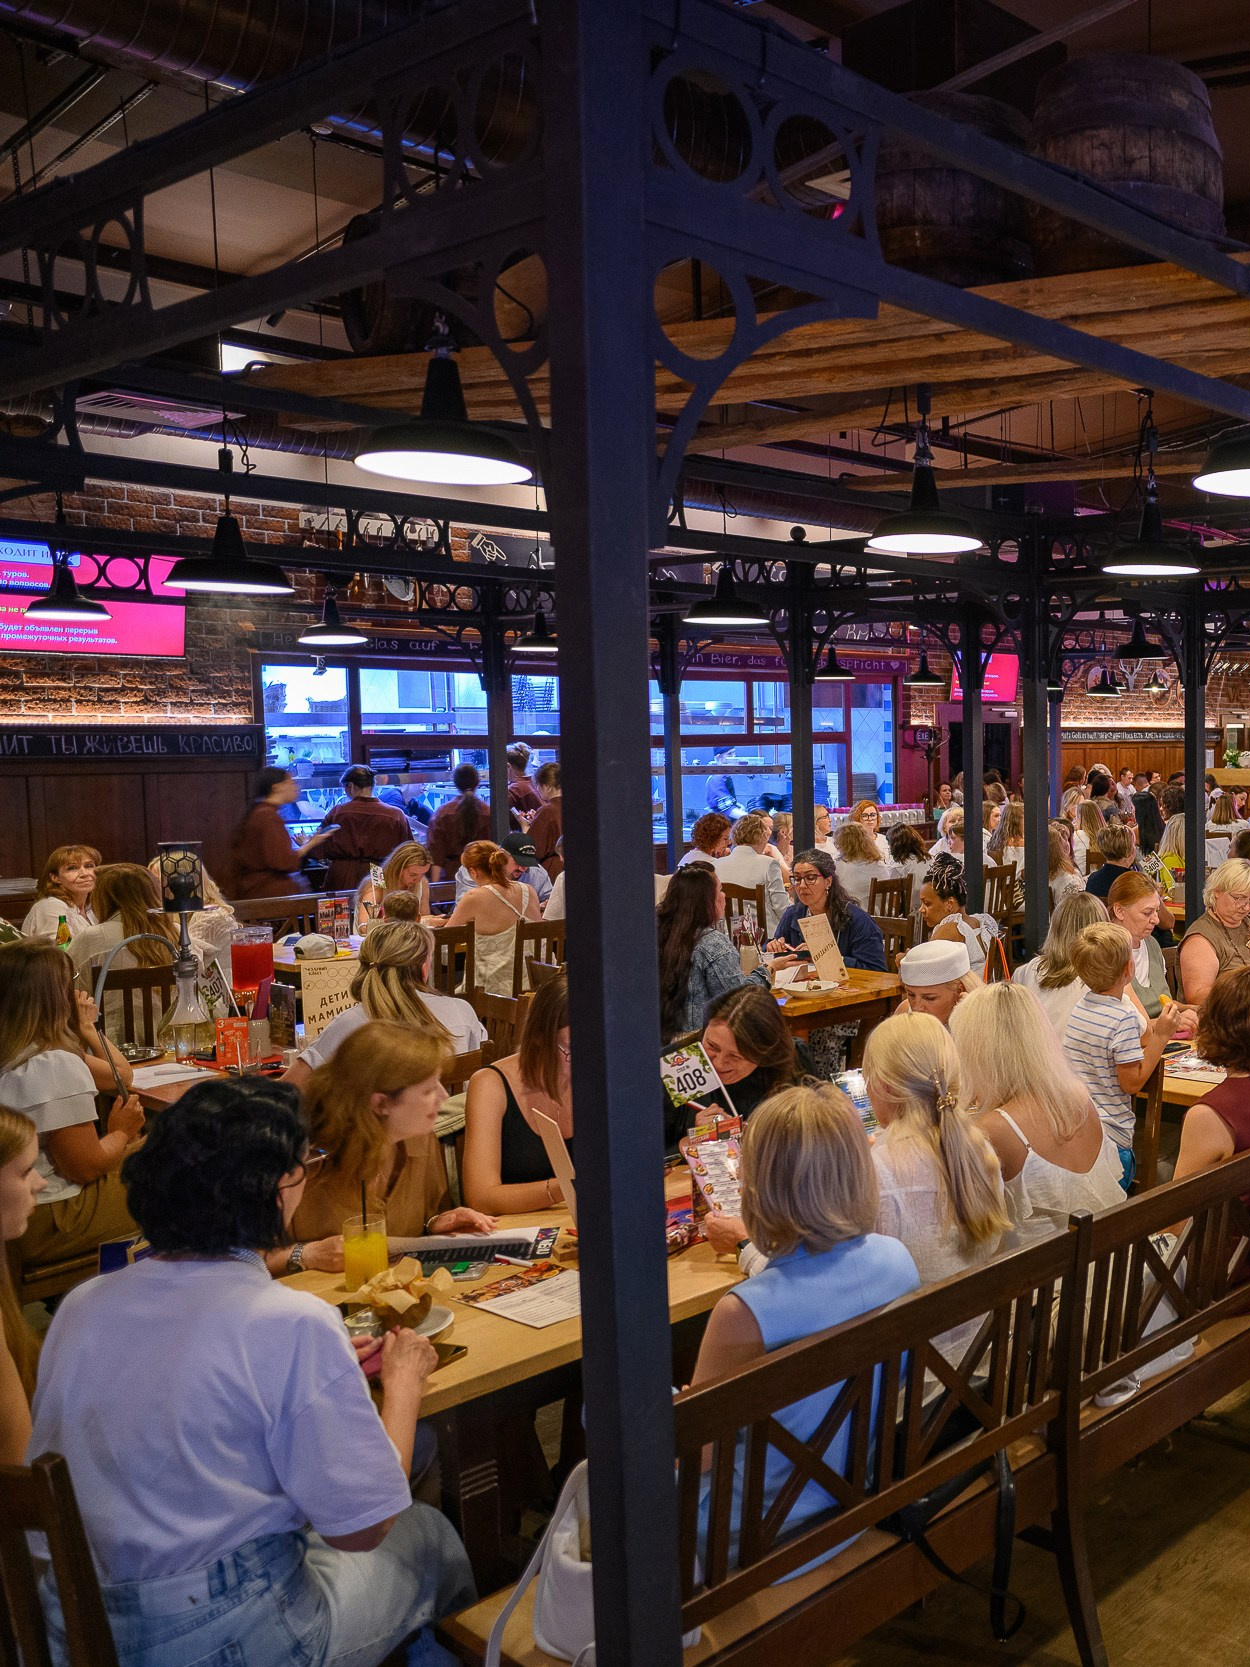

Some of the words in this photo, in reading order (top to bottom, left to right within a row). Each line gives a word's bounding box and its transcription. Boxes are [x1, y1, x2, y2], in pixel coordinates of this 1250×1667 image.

[1, 633, 67, 642] промежуточных
[69, 636, 118, 645] результатов.
[24, 624, 63, 633] объявлен
[65, 627, 98, 636] перерыв
[710, 653, 741, 666] Bier,
[747, 655, 766, 666] das
[0, 734, 33, 755] ИТ
[46, 735, 77, 754] ТЫ
[83, 735, 168, 754] ЖИВЕШЬ
[209, 977, 223, 997] 407
[320, 990, 349, 1009] ДЕТИ
[676, 1068, 707, 1094] 408
